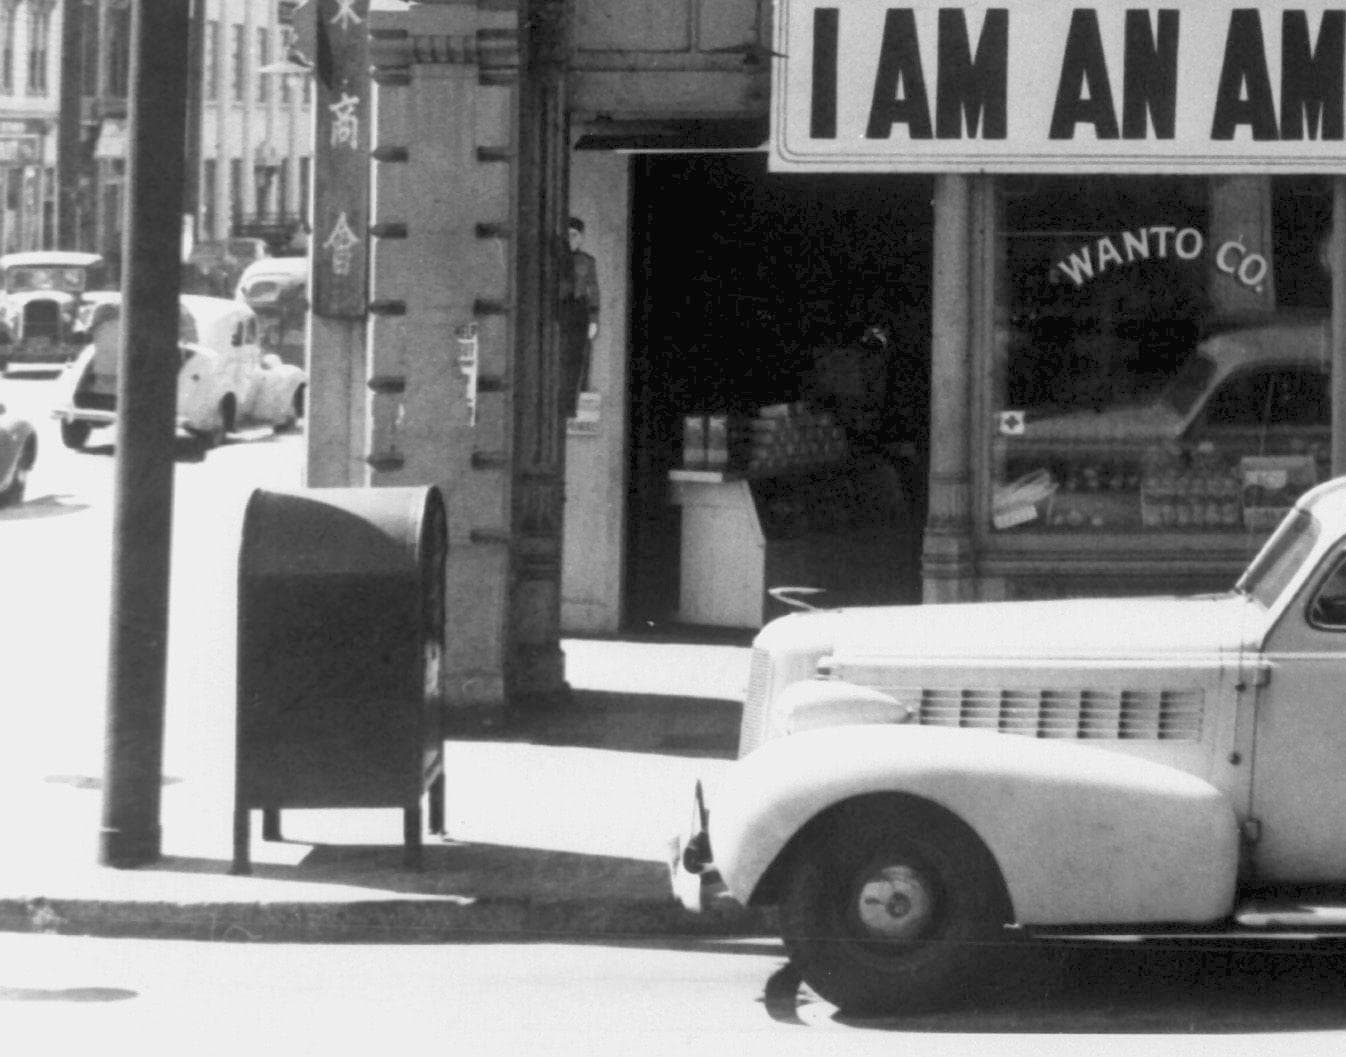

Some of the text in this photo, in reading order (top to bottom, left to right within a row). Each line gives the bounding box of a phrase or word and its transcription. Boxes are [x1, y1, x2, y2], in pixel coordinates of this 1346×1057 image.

[809, 6, 840, 140] I
[865, 7, 1009, 141] AM
[1048, 7, 1181, 141] AN
[1056, 225, 1204, 287] WANTO
